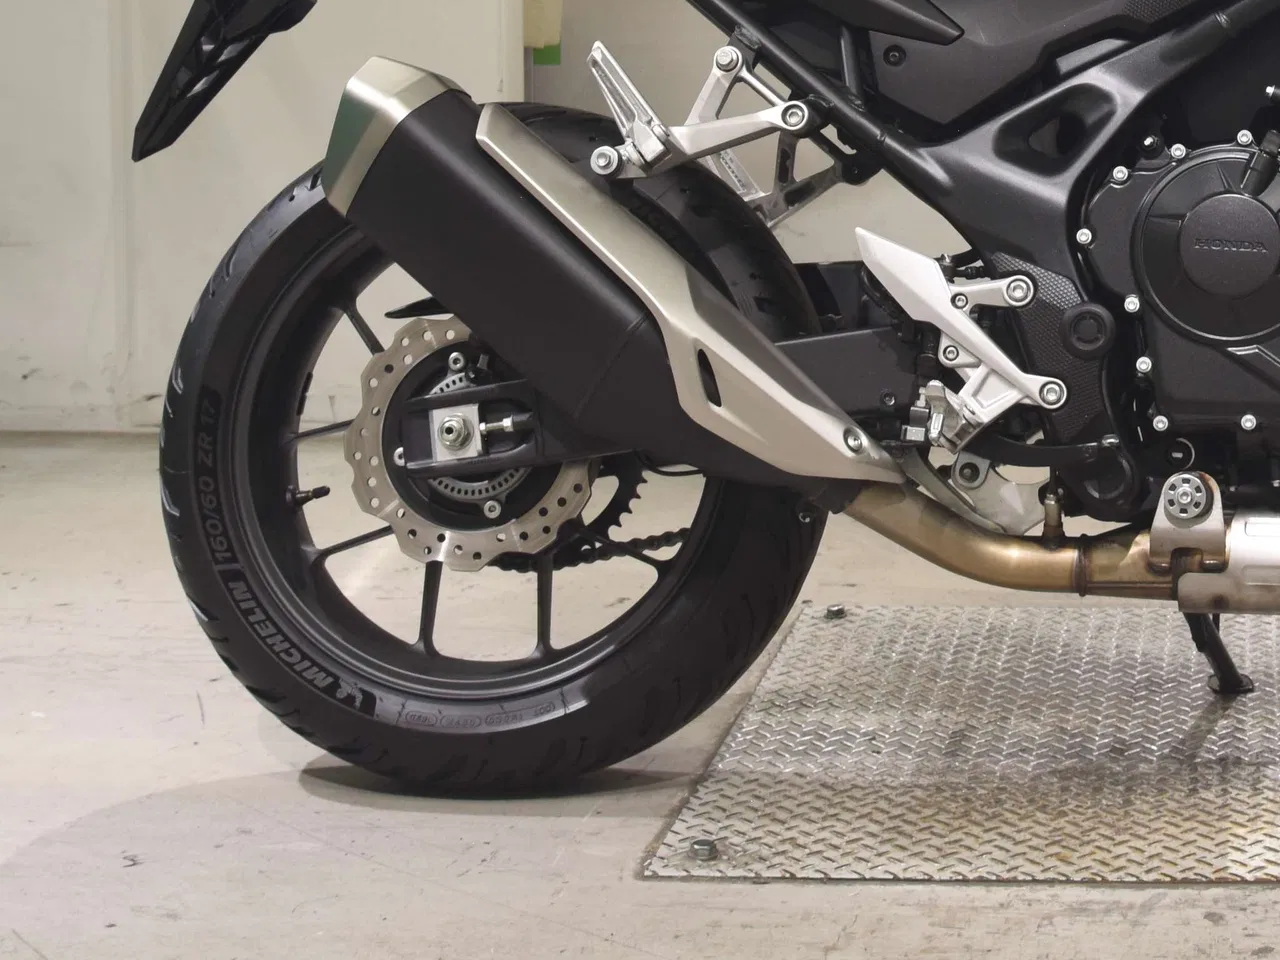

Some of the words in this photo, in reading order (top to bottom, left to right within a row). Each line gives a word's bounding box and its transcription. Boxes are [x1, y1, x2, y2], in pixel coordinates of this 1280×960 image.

[1193, 237, 1268, 253] HONDA
[198, 432, 215, 468] ZR
[198, 475, 232, 562] 160/60
[228, 580, 335, 689] MICHELIN
